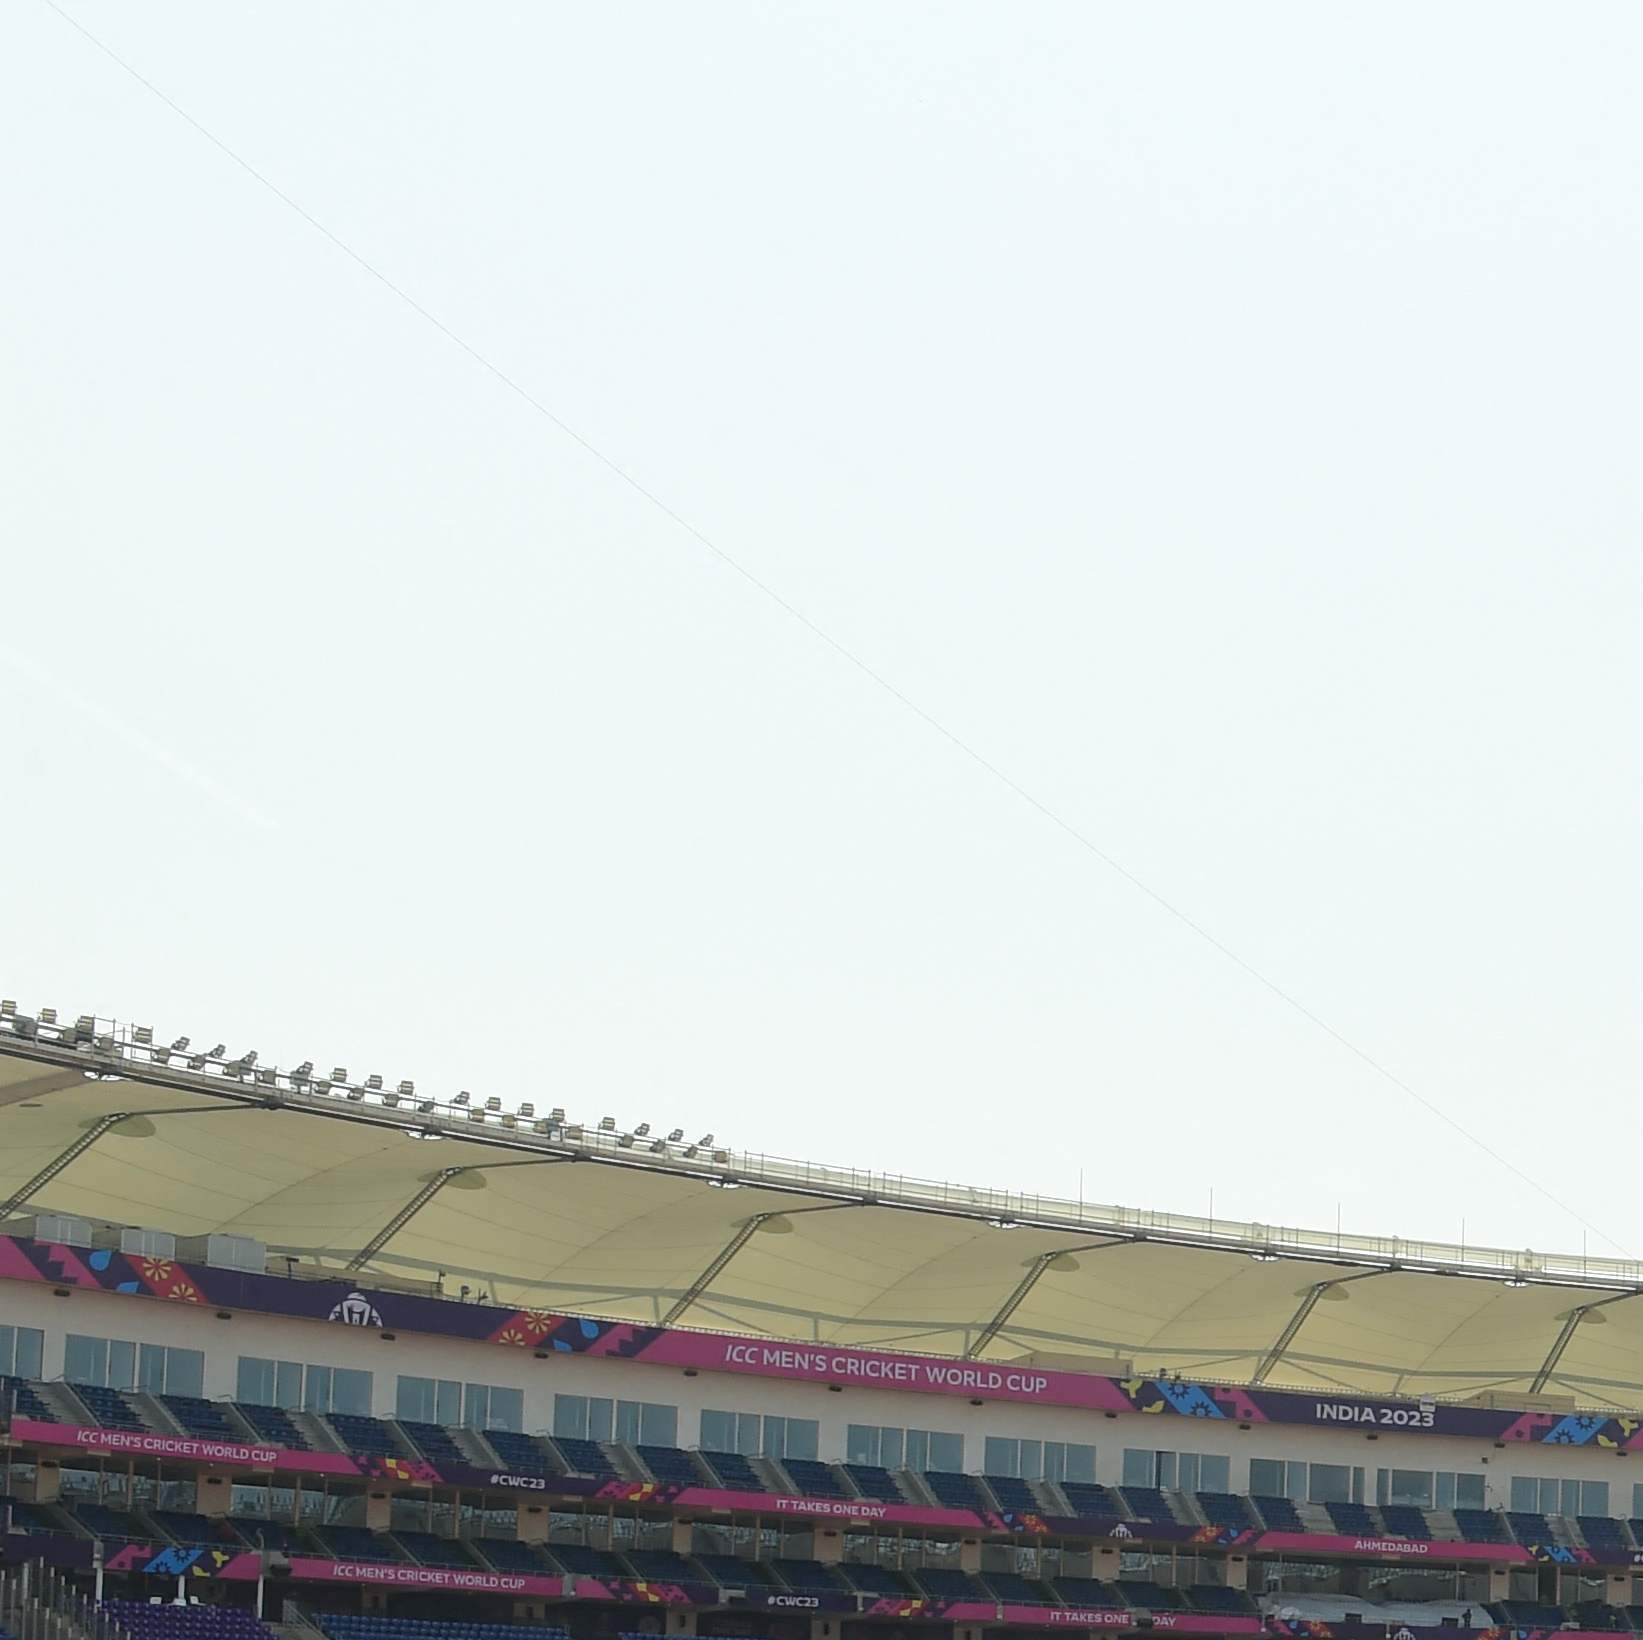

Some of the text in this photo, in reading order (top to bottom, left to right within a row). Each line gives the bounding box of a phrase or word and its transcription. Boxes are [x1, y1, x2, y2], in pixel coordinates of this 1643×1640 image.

[725, 1344, 1047, 1393] ICC MEN'S CRICKET WORLD CUP
[1316, 1403, 1435, 1427] INDIA 2023
[77, 1430, 278, 1463] ICC MEN'S CRICKET WORLD CUP
[490, 1474, 546, 1489] #CWC23
[775, 1499, 887, 1518] IT TAKES ONE DAY
[1354, 1540, 1428, 1553] AHMEDABAD
[333, 1564, 525, 1589] ICC MEN'S CRICKET WORLD CUP
[1050, 1611, 1177, 1627] IT TAKES ONE DAY
